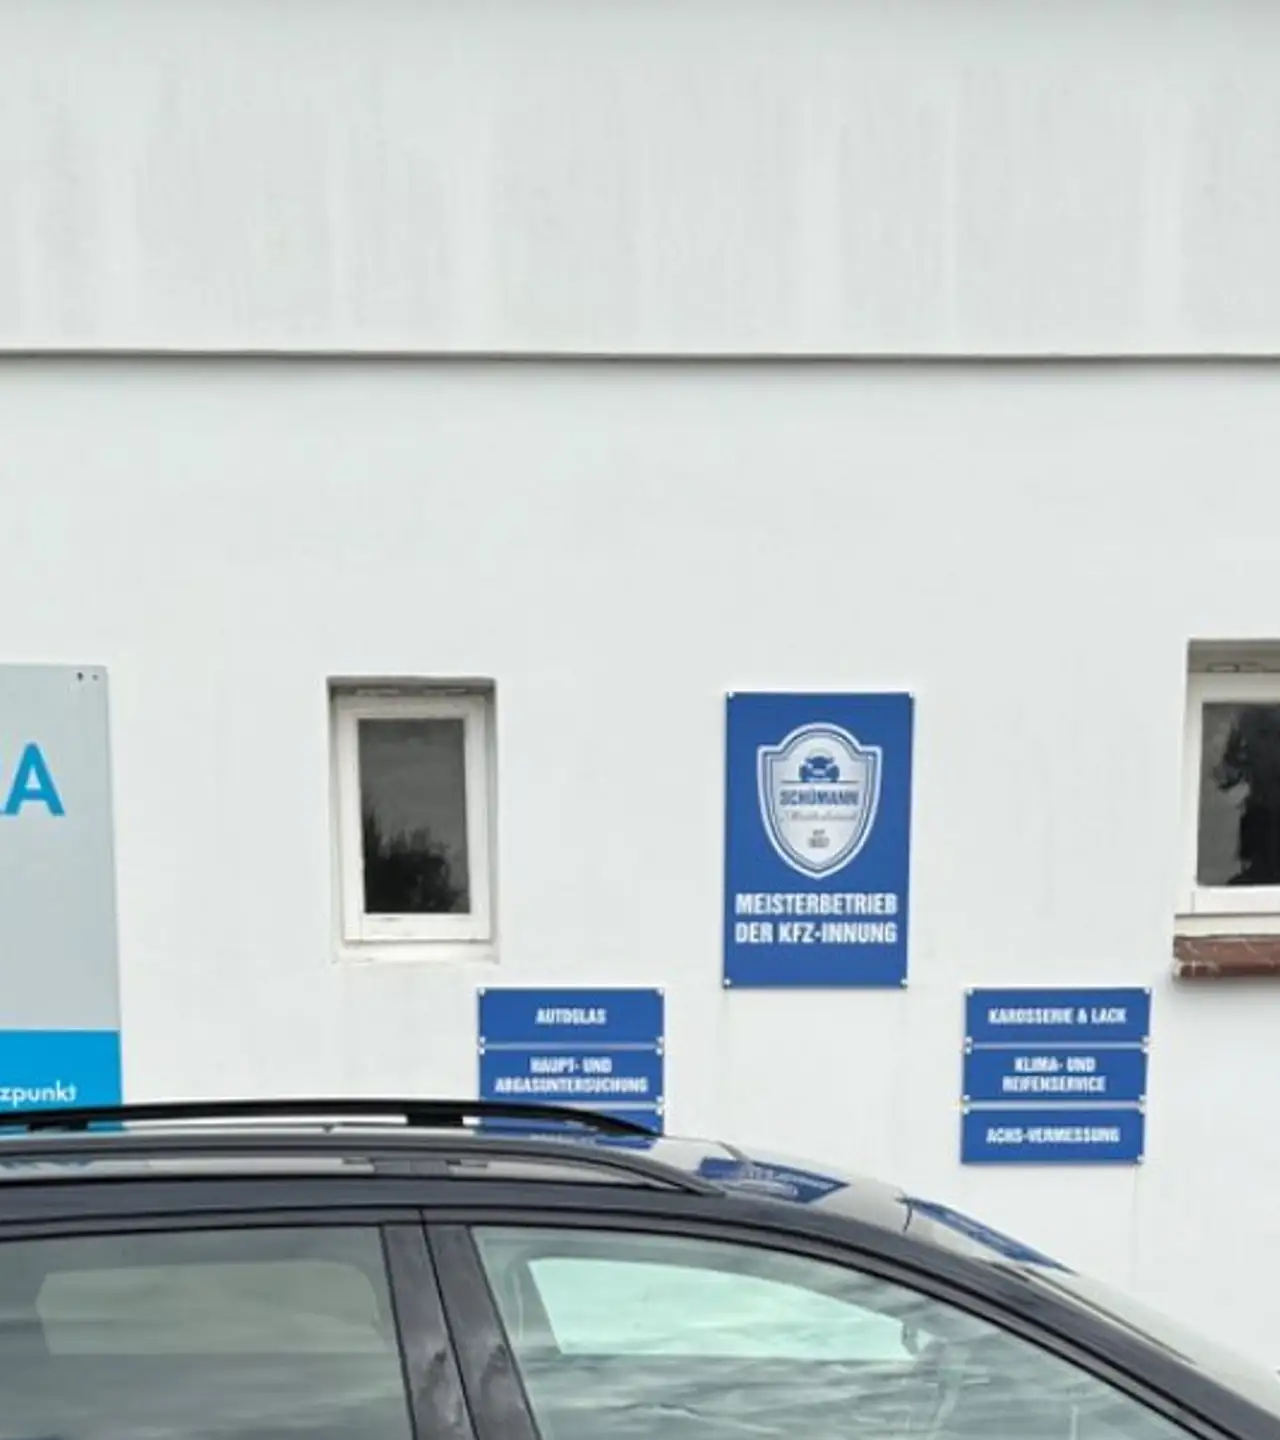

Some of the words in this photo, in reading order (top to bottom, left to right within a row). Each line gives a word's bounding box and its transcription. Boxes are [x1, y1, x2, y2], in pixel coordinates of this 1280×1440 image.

[734, 893, 898, 915] MEISTERBETRIEB
[734, 922, 773, 943] DER
[779, 922, 898, 943] KFZ-INNUNG
[535, 1008, 607, 1024] AUTOGLAS
[988, 1008, 1073, 1024] KAROSSERIE
[1091, 1008, 1127, 1024] LACK
[530, 1057, 579, 1073] HAUPT-
[582, 1057, 613, 1073] UND
[1014, 1057, 1063, 1072] KLIMA-
[1067, 1057, 1096, 1072] UND
[494, 1077, 649, 1093] ABGASUNTERSUCHUNG
[1002, 1076, 1107, 1092] REIFENSERVICE
[986, 1128, 1121, 1144] ACHS-VERMESSUNG
